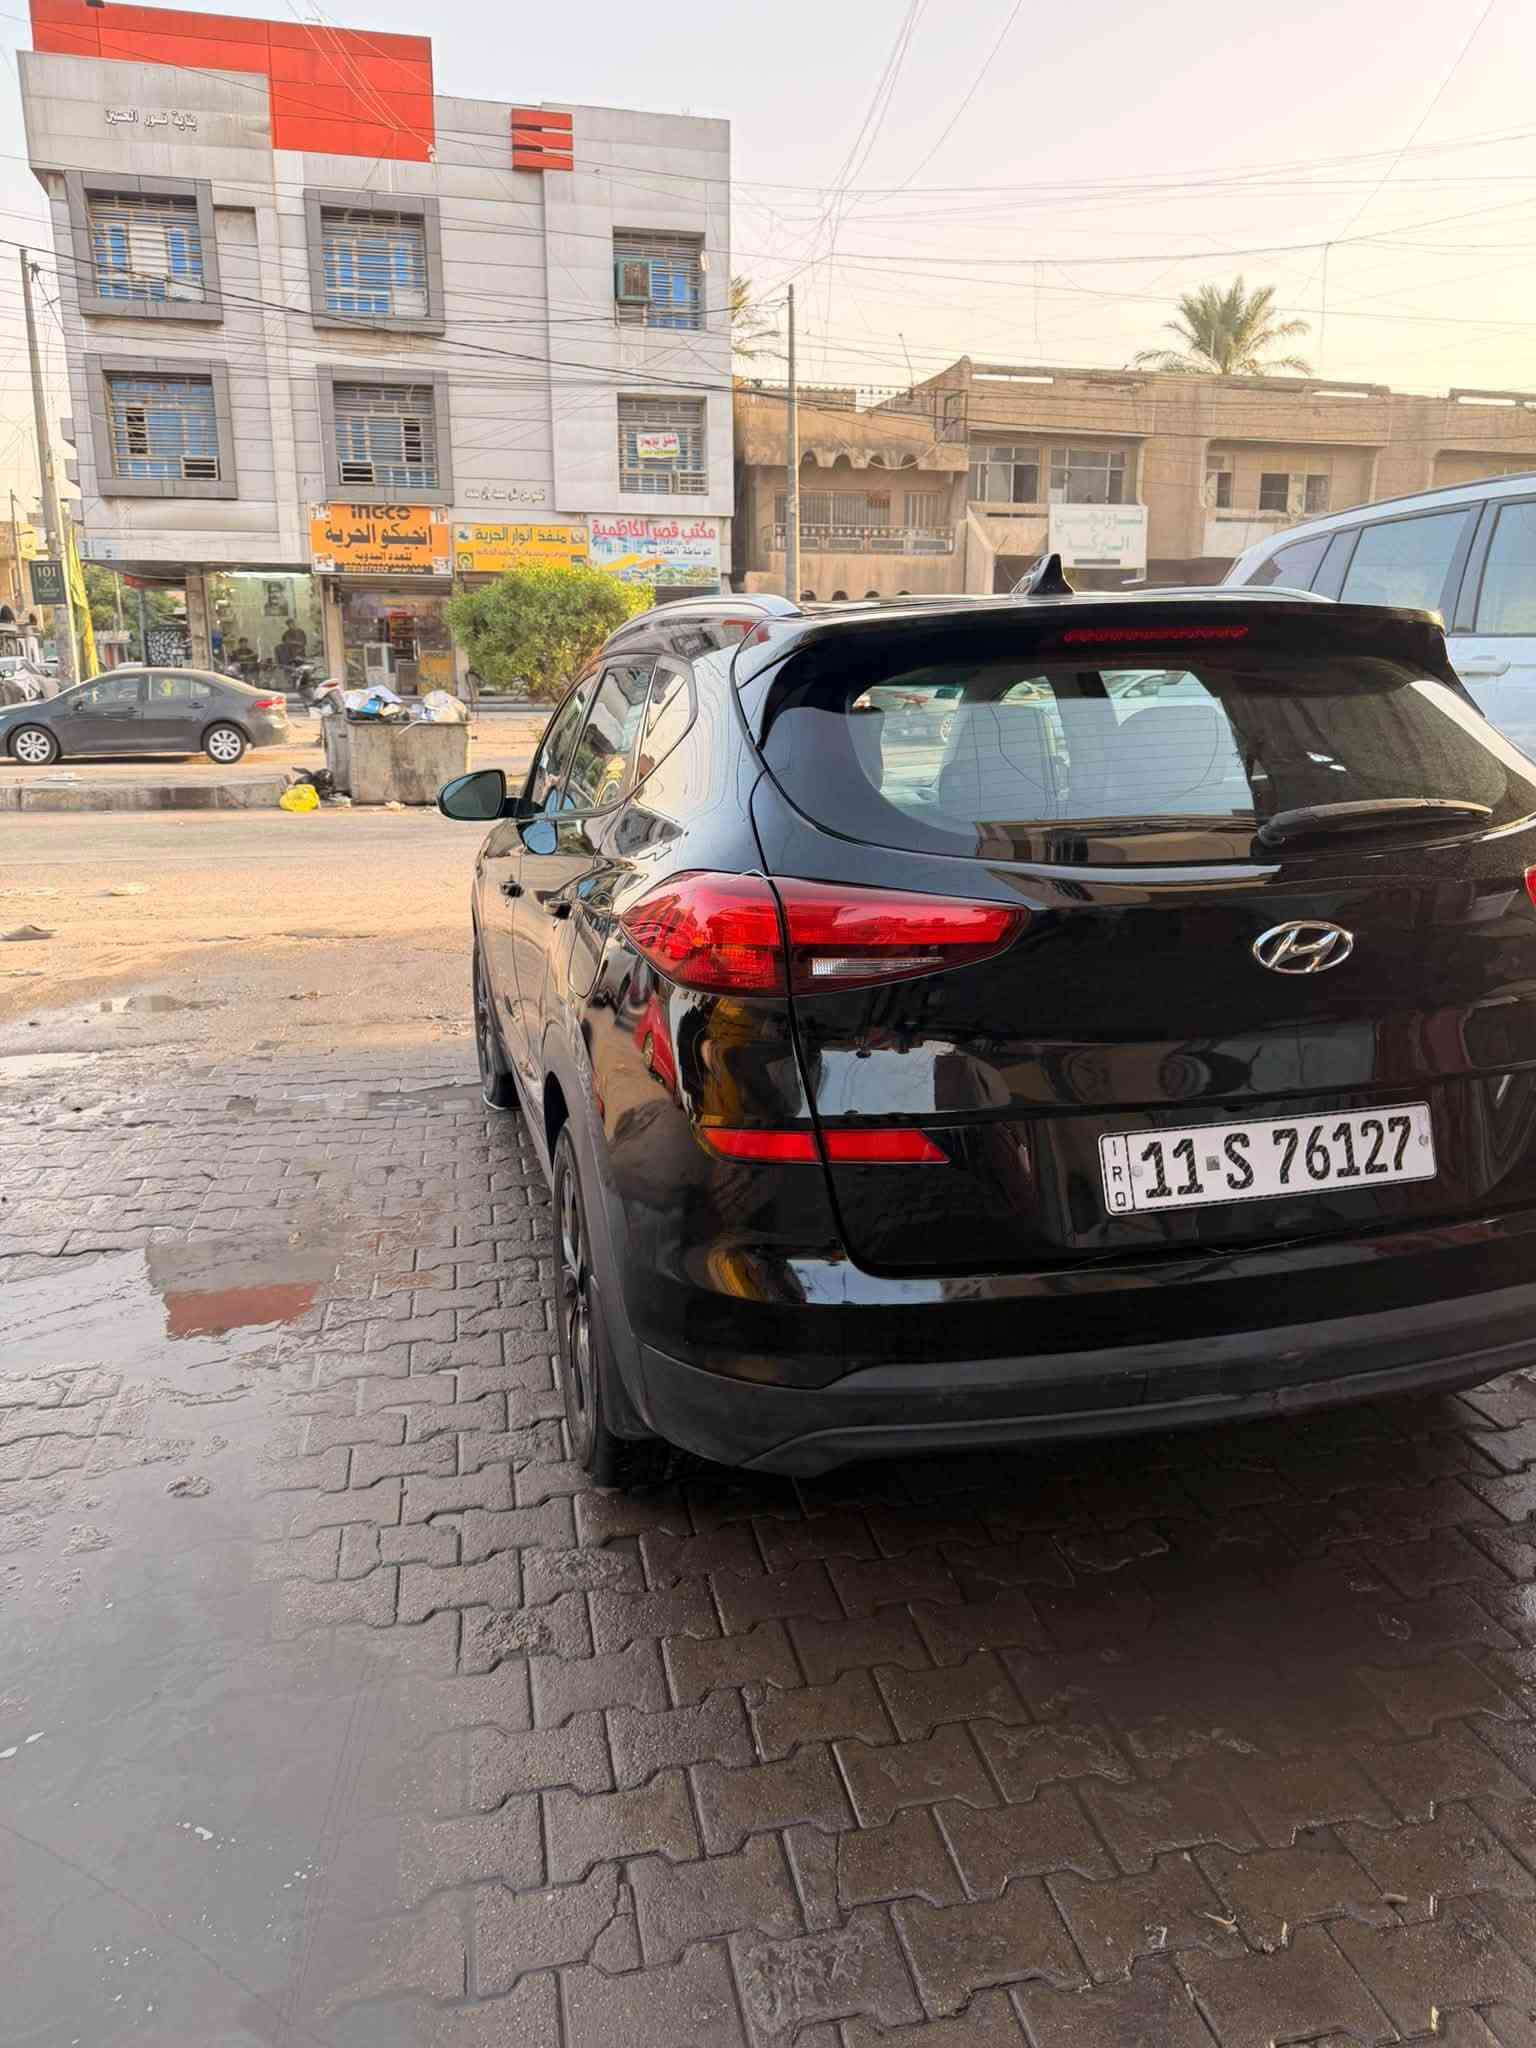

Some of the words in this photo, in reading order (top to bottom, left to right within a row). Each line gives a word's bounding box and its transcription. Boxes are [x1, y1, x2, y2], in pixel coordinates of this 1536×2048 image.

[171, 110, 197, 132] بناية
[324, 521, 376, 549] الحرية
[475, 527, 508, 545] الحرية
[591, 519, 649, 540] الكاظمية
[652, 521, 679, 541] قصر
[681, 521, 716, 543] مكتب
[37, 566, 56, 577] 101
[1140, 1137, 1204, 1198] 11
[1223, 1132, 1254, 1190] S
[1271, 1115, 1411, 1184] 76127
[1110, 1139, 1128, 1207] IRQ
